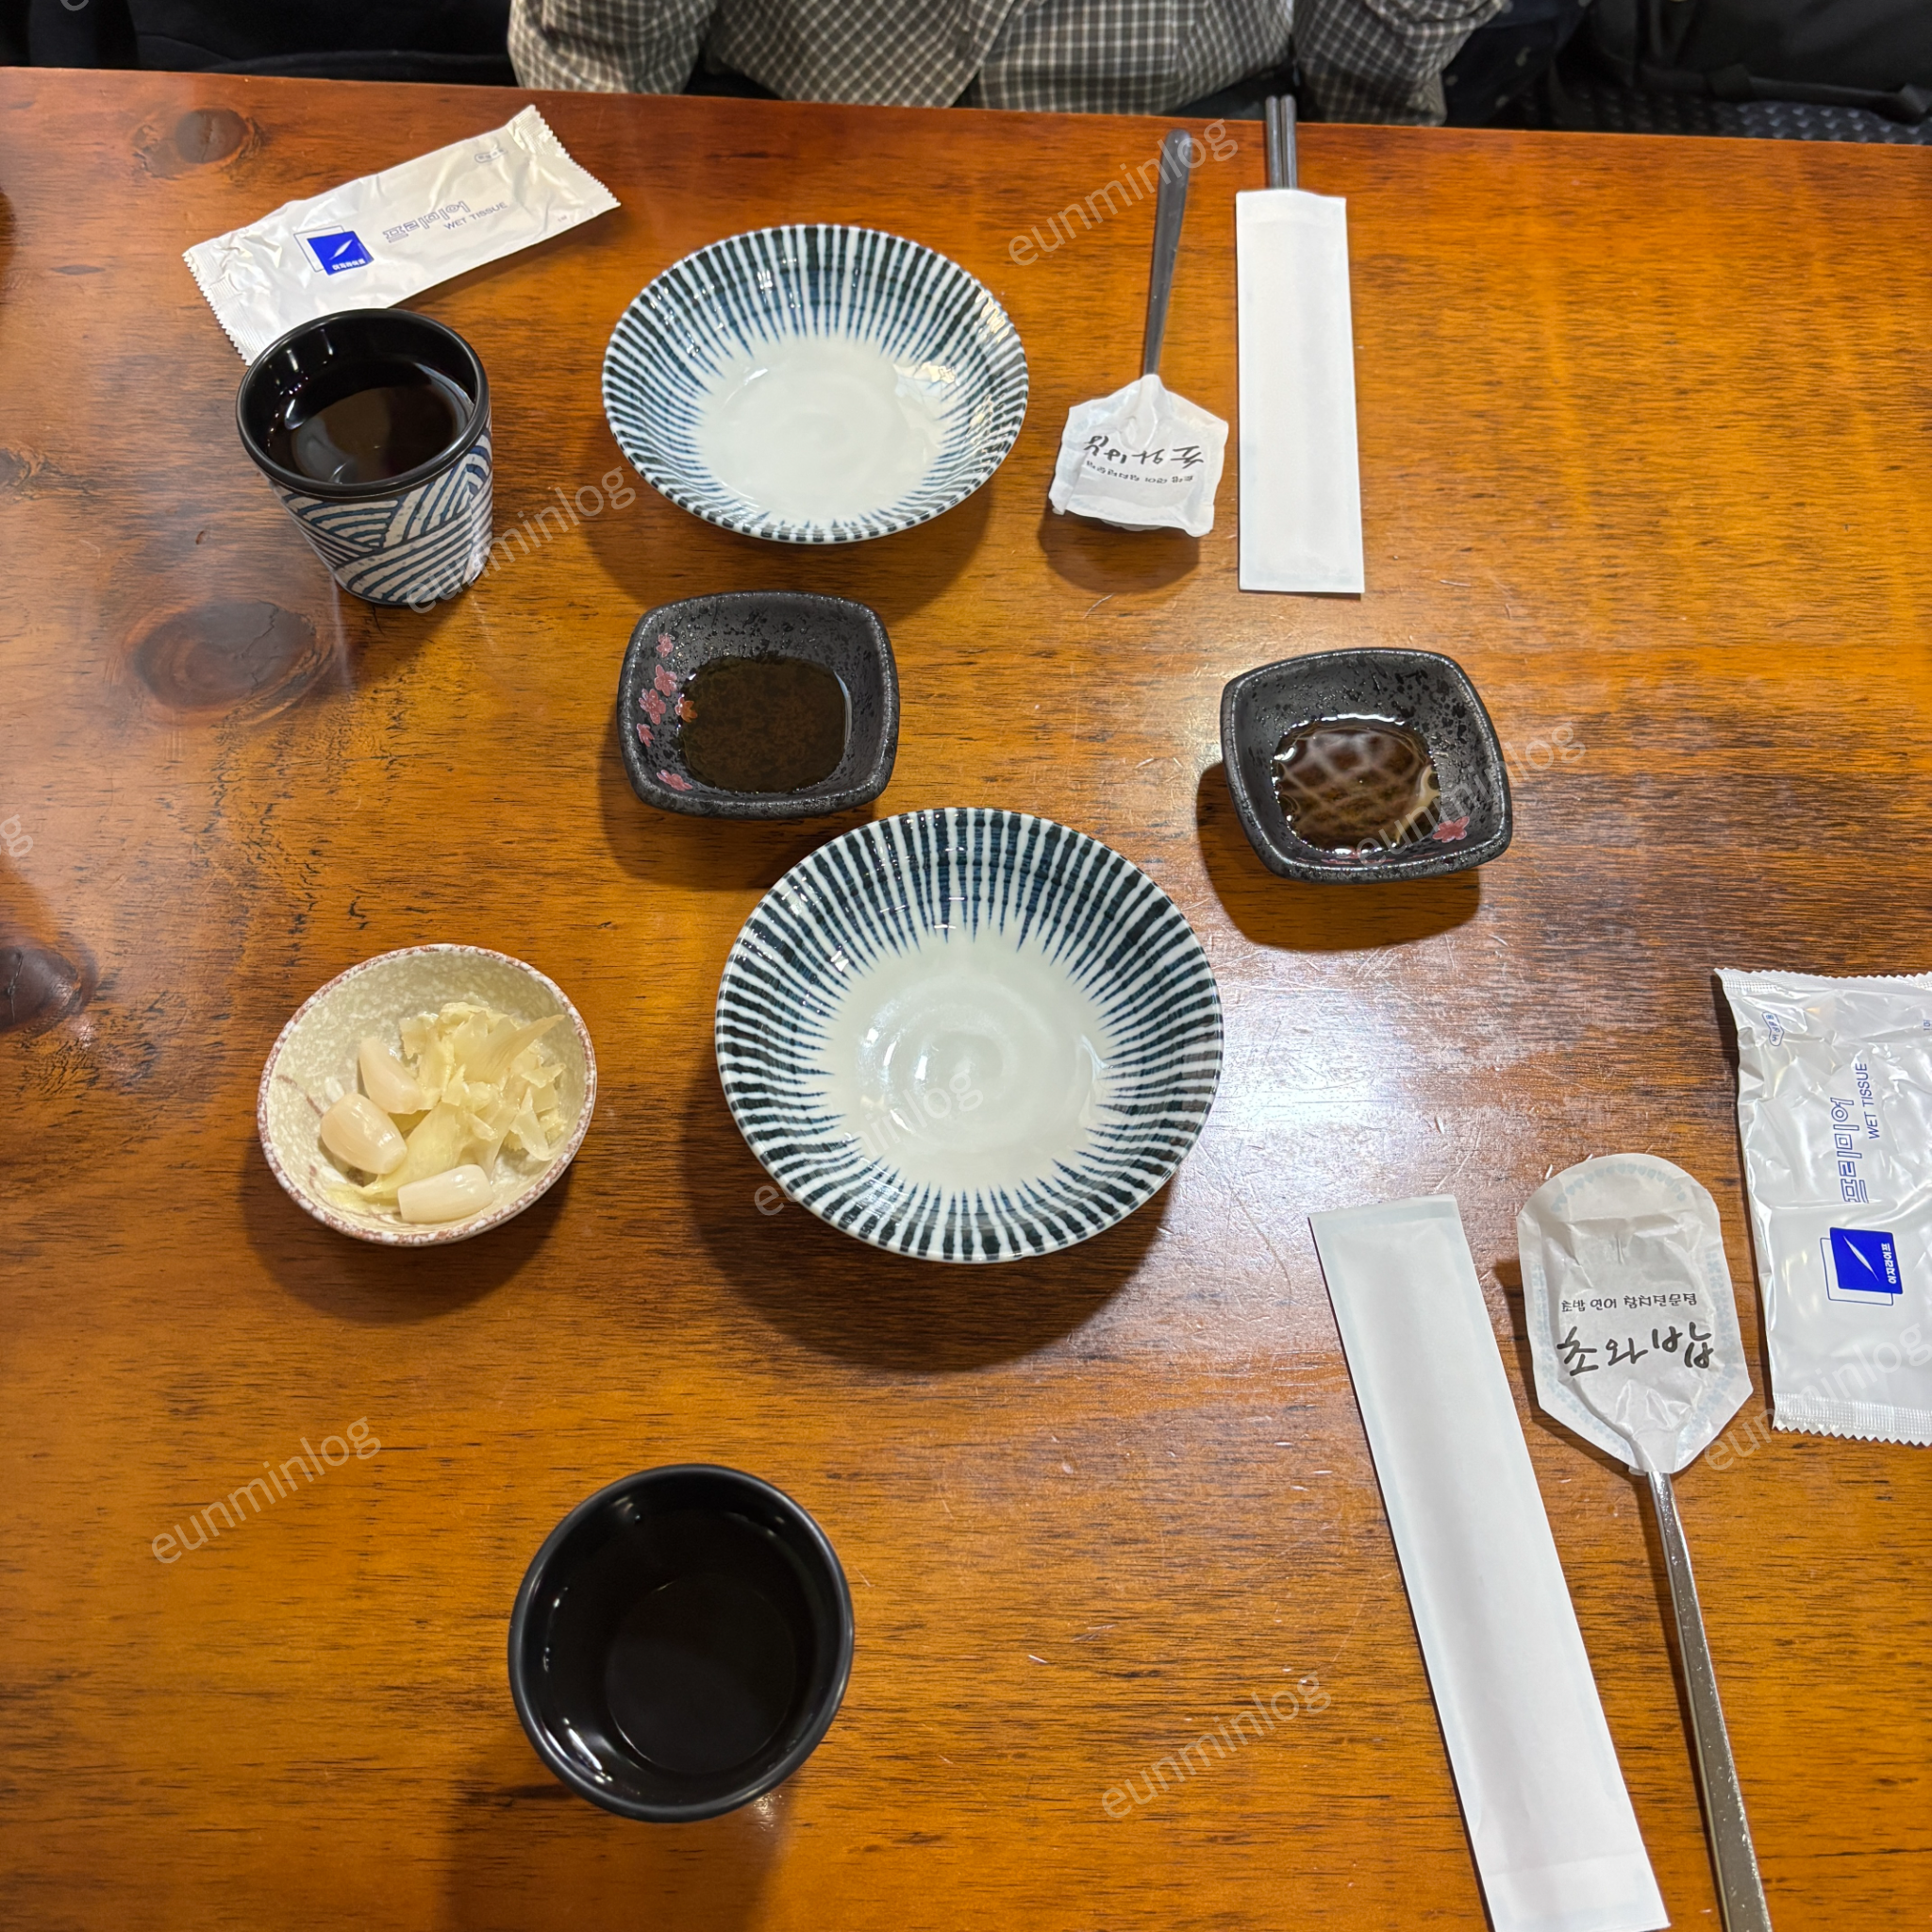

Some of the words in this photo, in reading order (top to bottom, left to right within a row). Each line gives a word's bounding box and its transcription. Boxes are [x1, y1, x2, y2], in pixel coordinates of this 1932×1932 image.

[382, 200, 471, 243] 프리미어
[443, 216, 467, 230] WET
[471, 201, 508, 221] TISSUE
[1855, 1063, 1874, 1108] TISSUE
[1864, 1111, 1880, 1140] WET
[1830, 1097, 1869, 1204] 프리미어
[1881, 1242, 1897, 1285] 이지라이프
[1561, 1300, 1585, 1312] 초밥
[1590, 1298, 1617, 1311] 연어
[1624, 1292, 1697, 1308] 참치전문점
[1557, 1322, 1714, 1376] 초와밥
